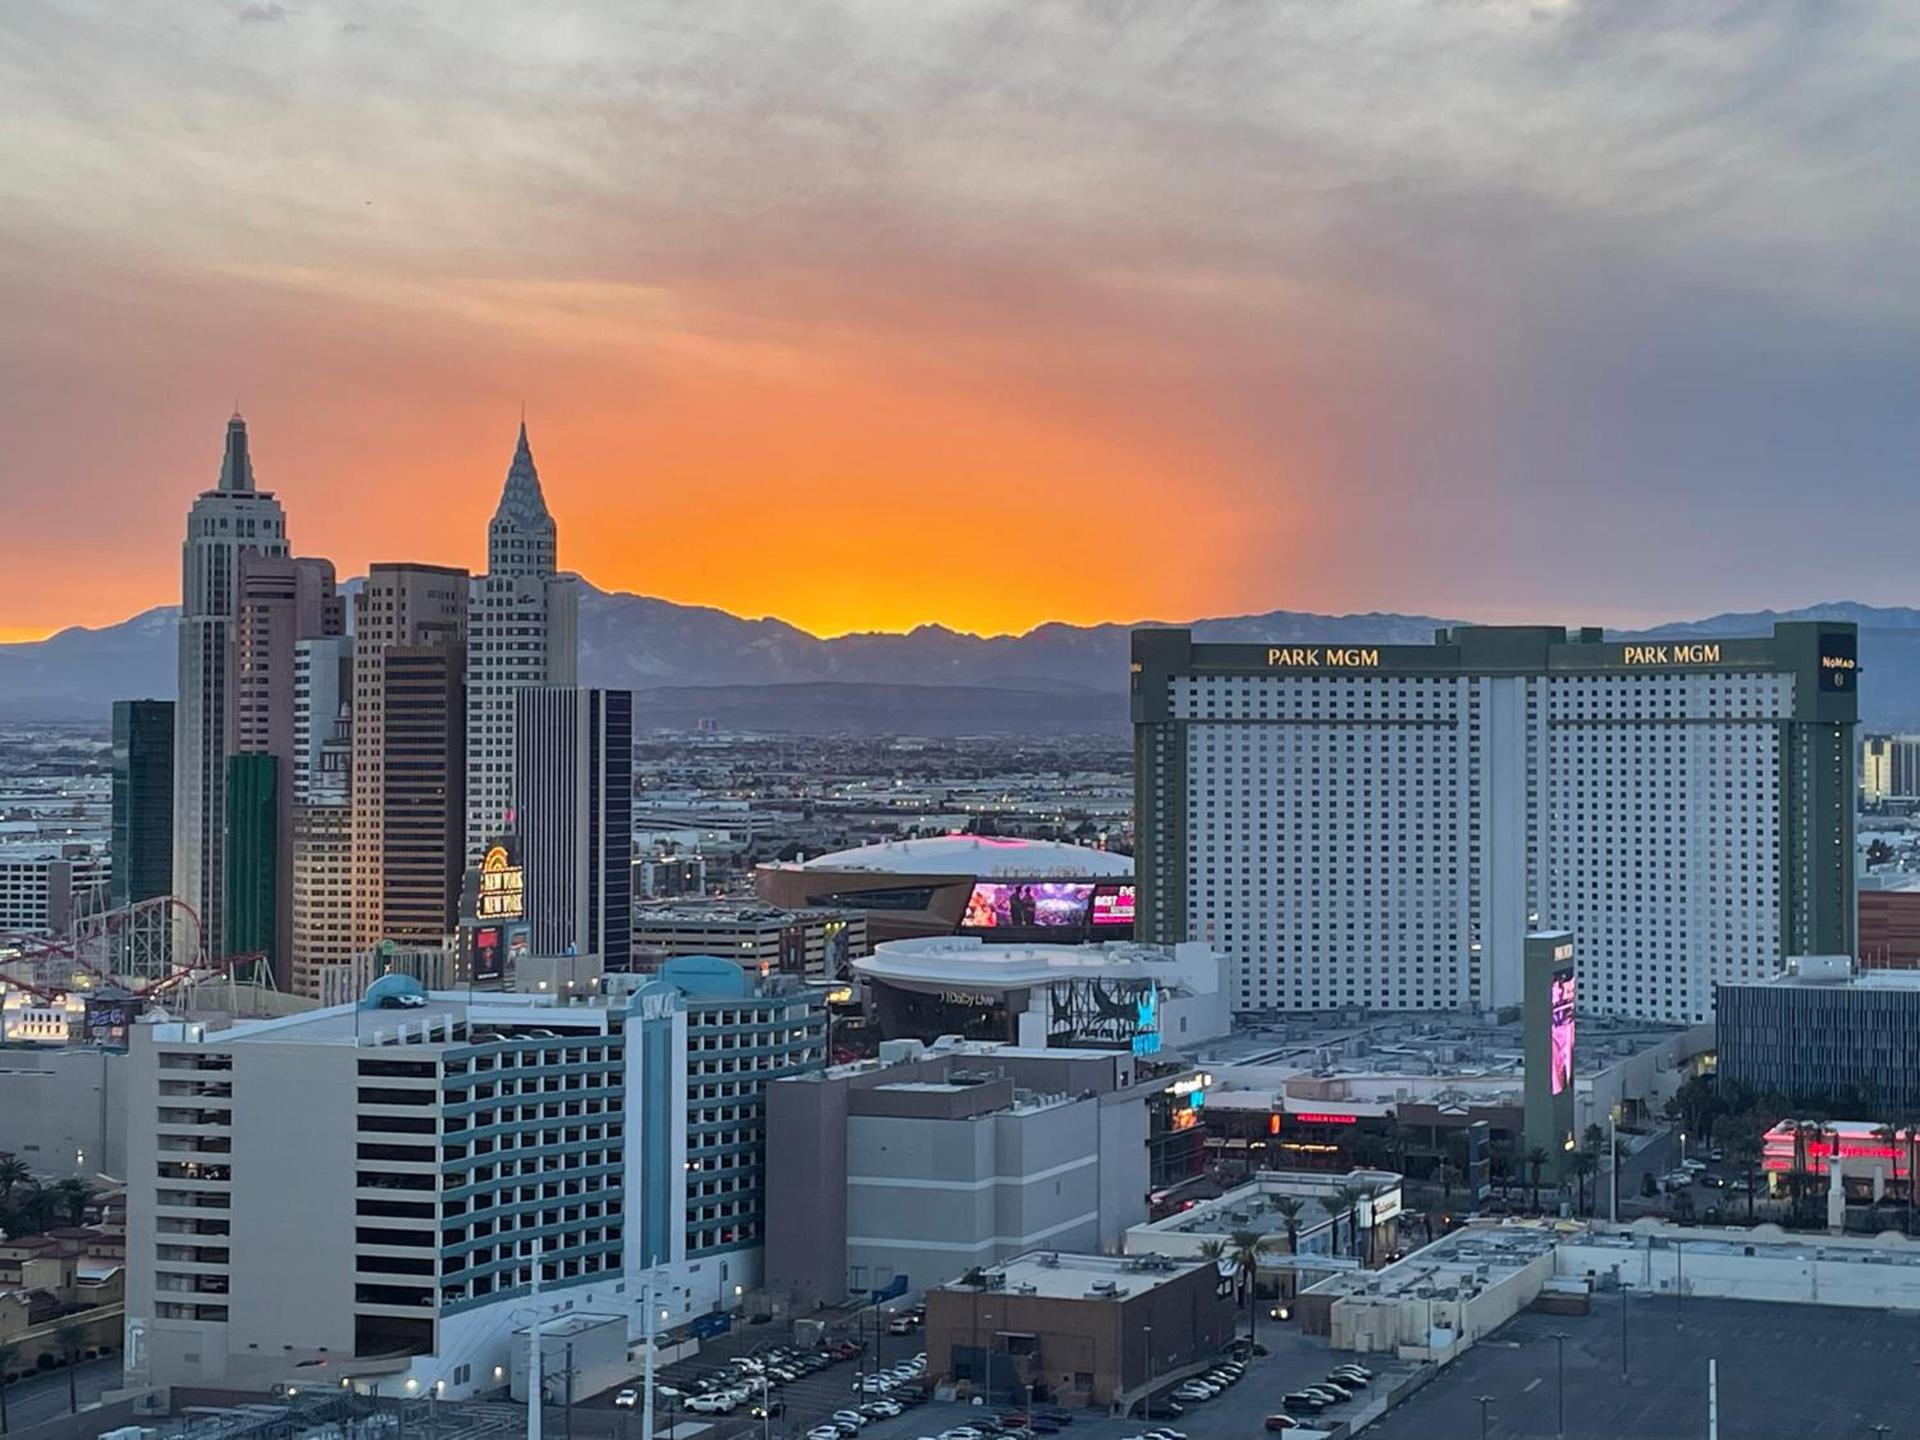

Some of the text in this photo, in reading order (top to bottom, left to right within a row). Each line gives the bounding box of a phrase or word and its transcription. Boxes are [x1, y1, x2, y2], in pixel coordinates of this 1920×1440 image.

[1268, 648, 1379, 667] PARK MGM
[1624, 645, 1720, 664] PARK MGM
[484, 870, 523, 891] NEW YORK
[484, 893, 523, 914] NEW YORK
